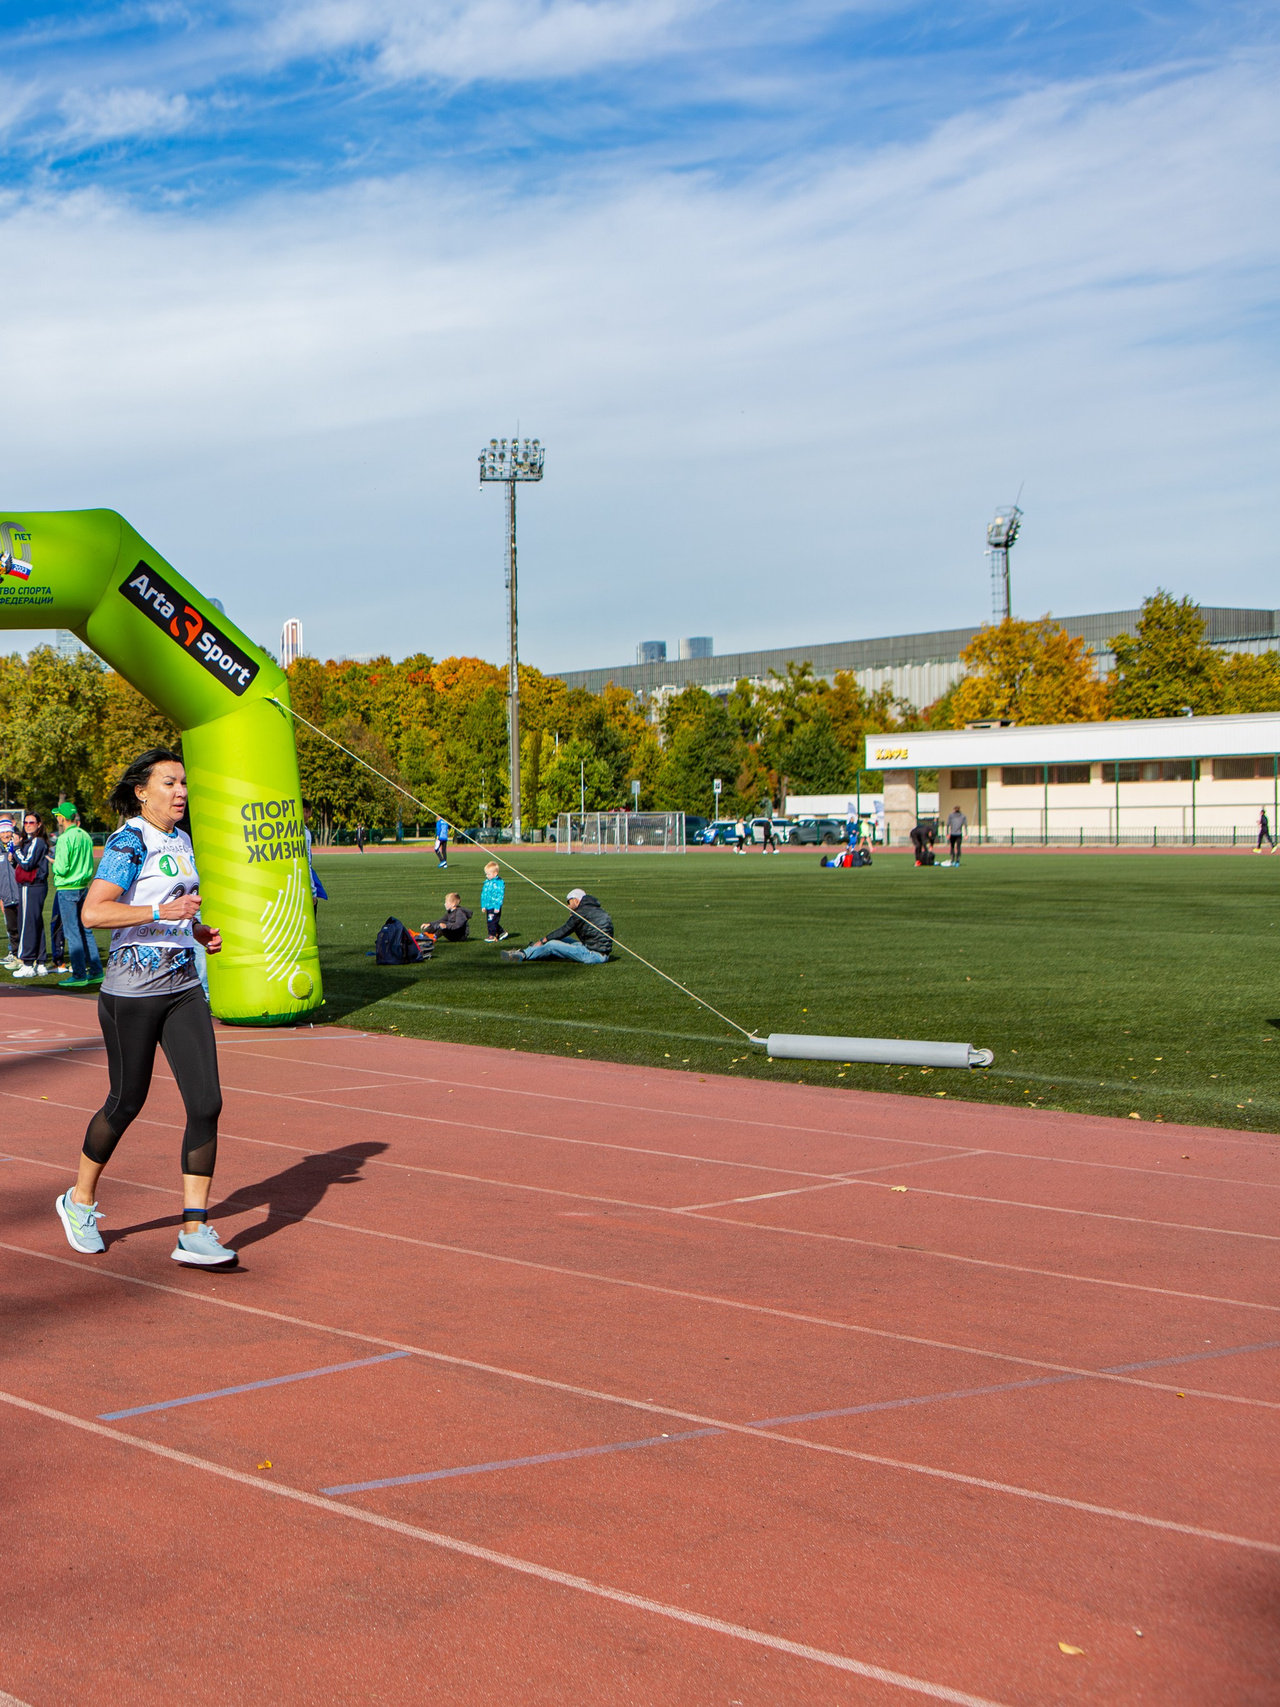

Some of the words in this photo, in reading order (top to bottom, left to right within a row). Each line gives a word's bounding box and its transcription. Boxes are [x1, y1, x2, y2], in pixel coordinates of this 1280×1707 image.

[14, 533, 32, 541] ЛЕТ
[13, 564, 28, 575] 2023
[17, 586, 52, 595] СПОРТА
[128, 574, 176, 620] Arta
[196, 631, 251, 686] Sport
[240, 798, 296, 822] СПОРТ
[243, 819, 305, 843] НОРМА
[246, 839, 307, 864] ЖИЗНИ
